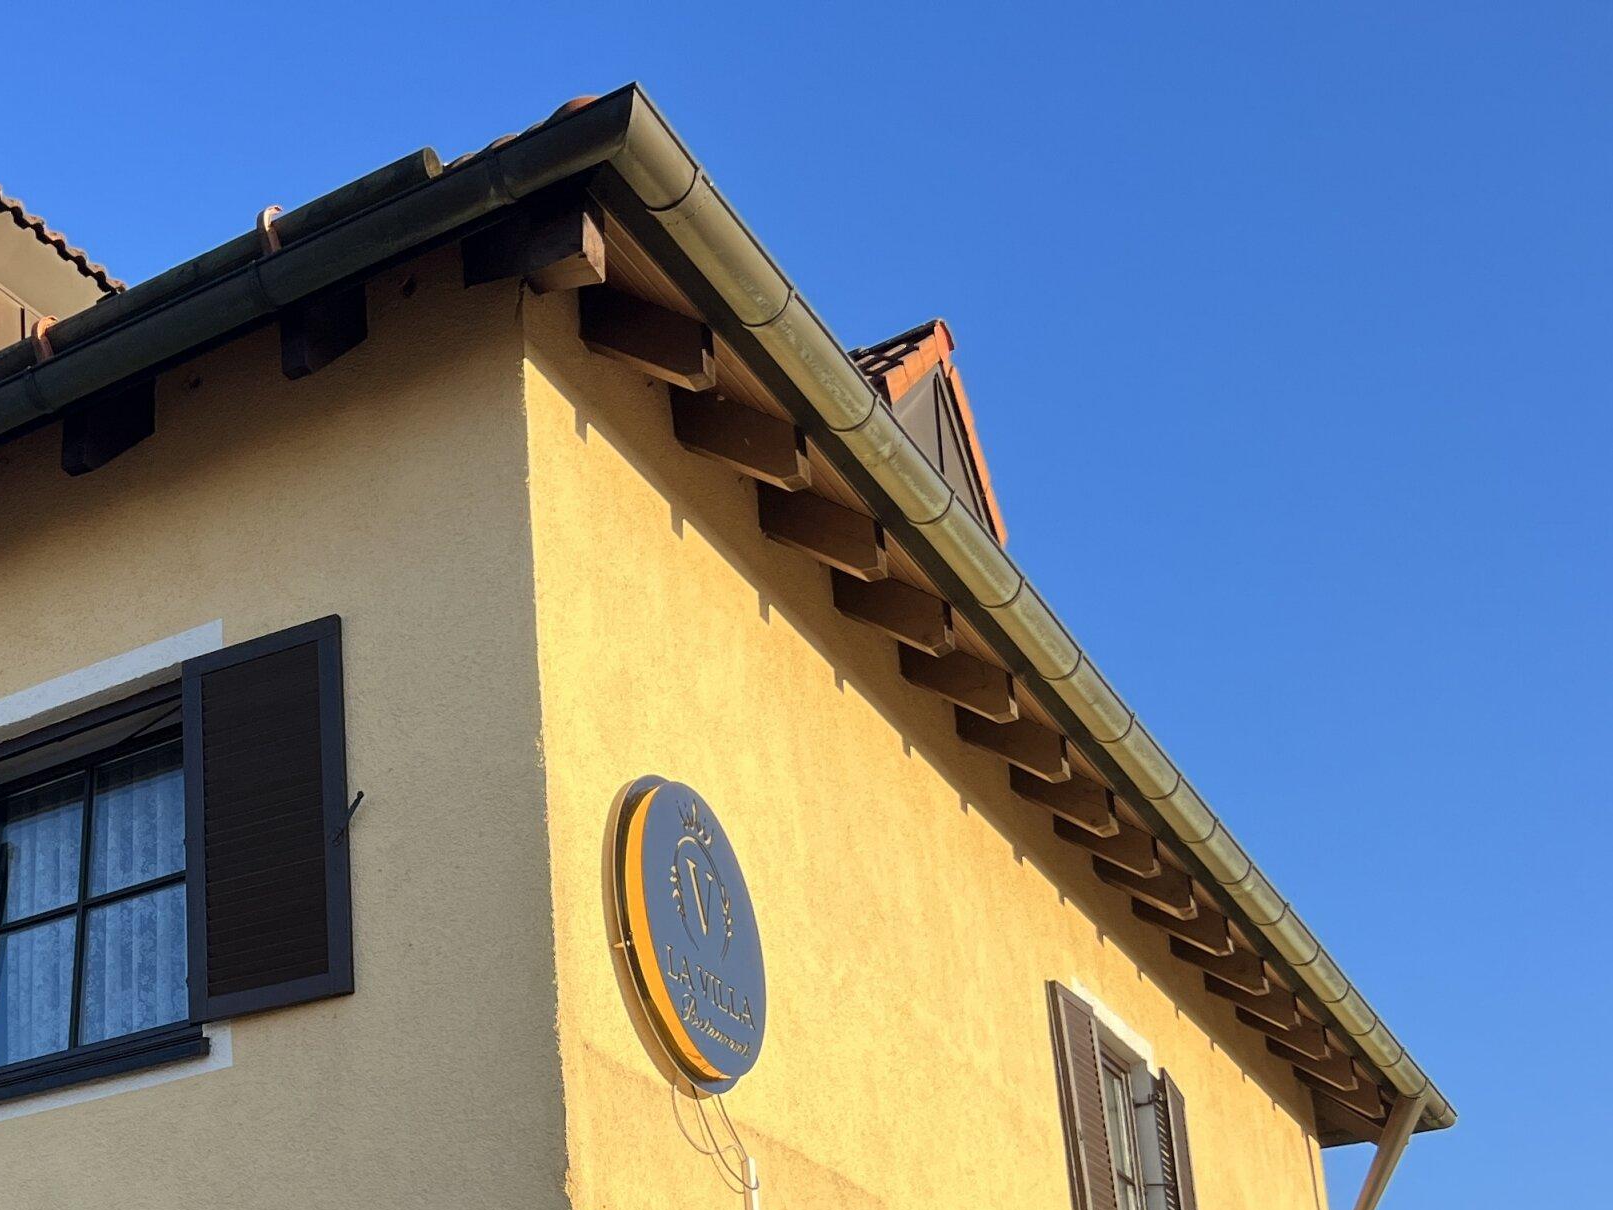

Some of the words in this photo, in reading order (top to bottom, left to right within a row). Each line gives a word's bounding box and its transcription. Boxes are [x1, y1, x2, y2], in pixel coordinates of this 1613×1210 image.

[666, 943, 695, 991] LA
[696, 964, 756, 1032] VILLA
[681, 993, 751, 1059] Restaurant
